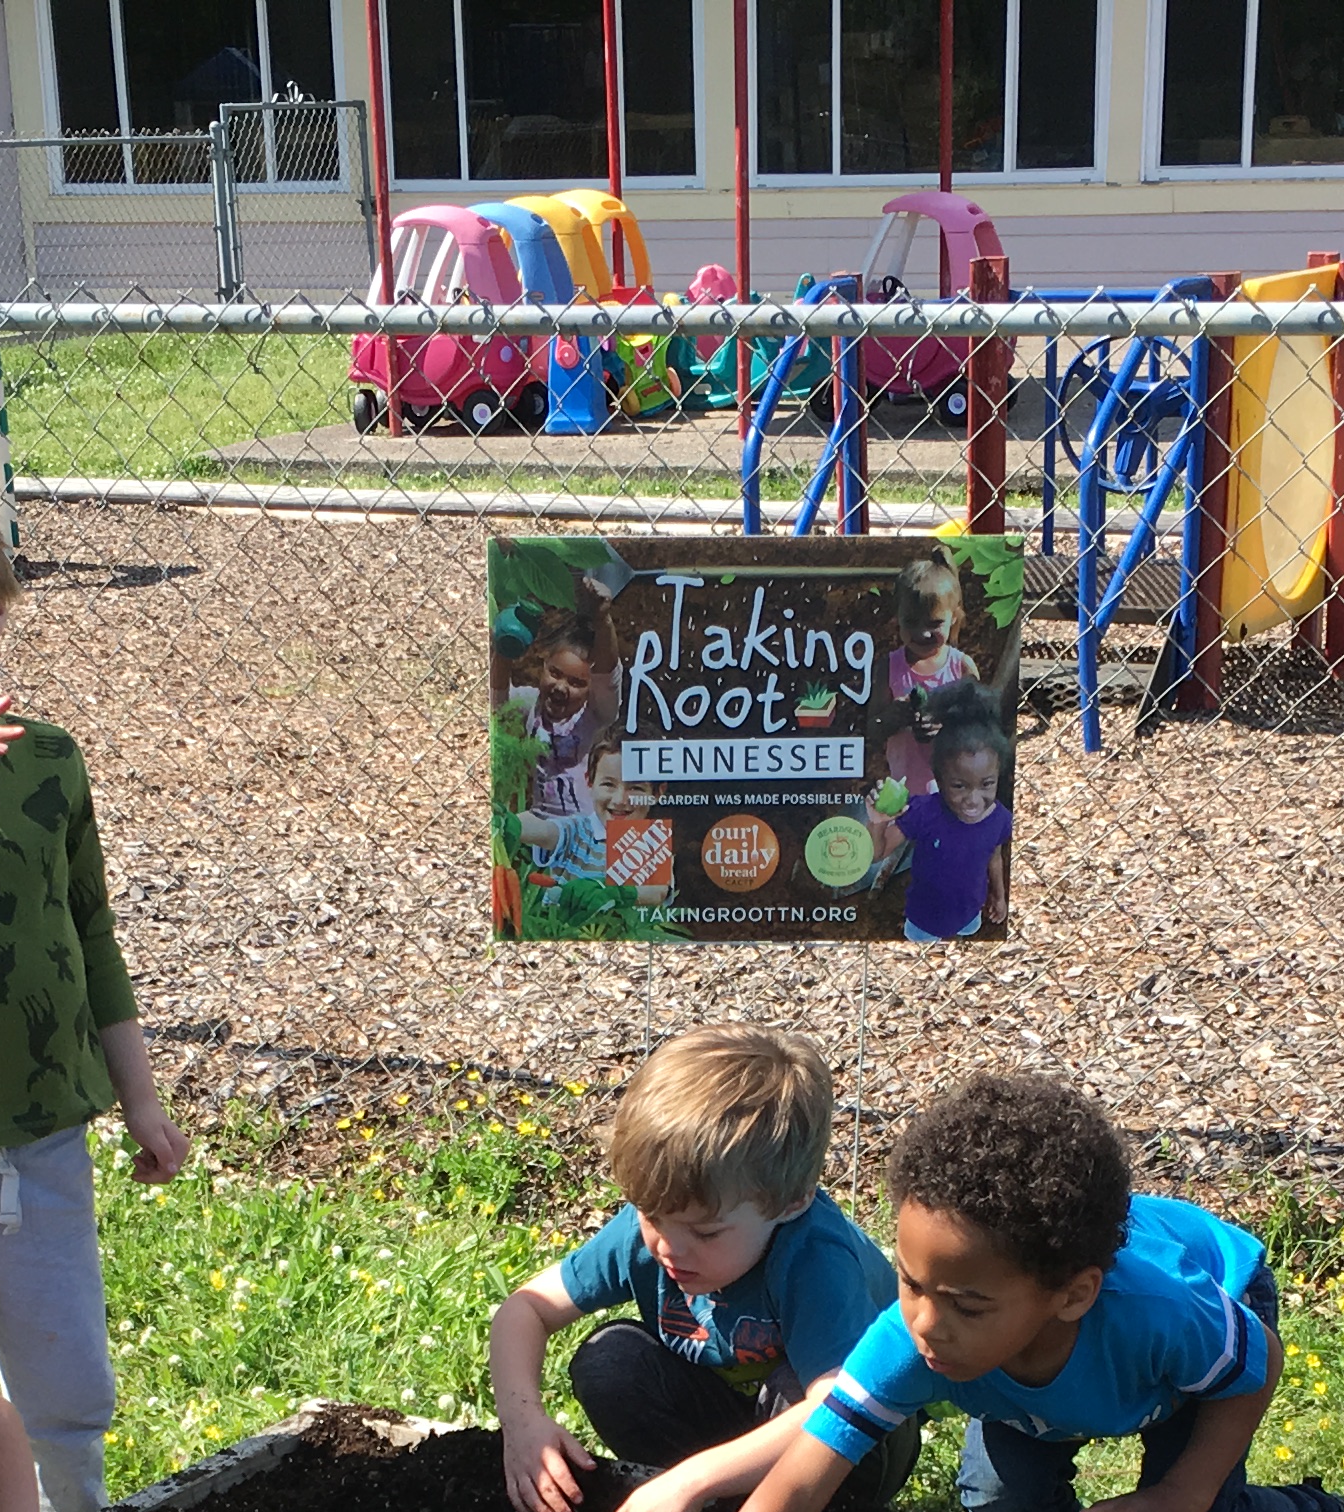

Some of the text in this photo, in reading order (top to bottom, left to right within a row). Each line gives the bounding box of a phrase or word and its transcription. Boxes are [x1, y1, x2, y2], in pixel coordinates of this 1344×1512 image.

[656, 575, 874, 704] Taking
[626, 631, 787, 733] Root
[631, 744, 855, 774] TENNESSEE
[628, 793, 864, 806] THIS GARDEN WAS MADE POSSIBLE BY:
[612, 826, 640, 853] THE
[711, 827, 751, 840] our
[606, 819, 672, 886] HOME
[632, 843, 672, 886] DEPOT
[720, 866, 757, 878] bread
[636, 906, 857, 922] TAKINGROOTTN.ORG
